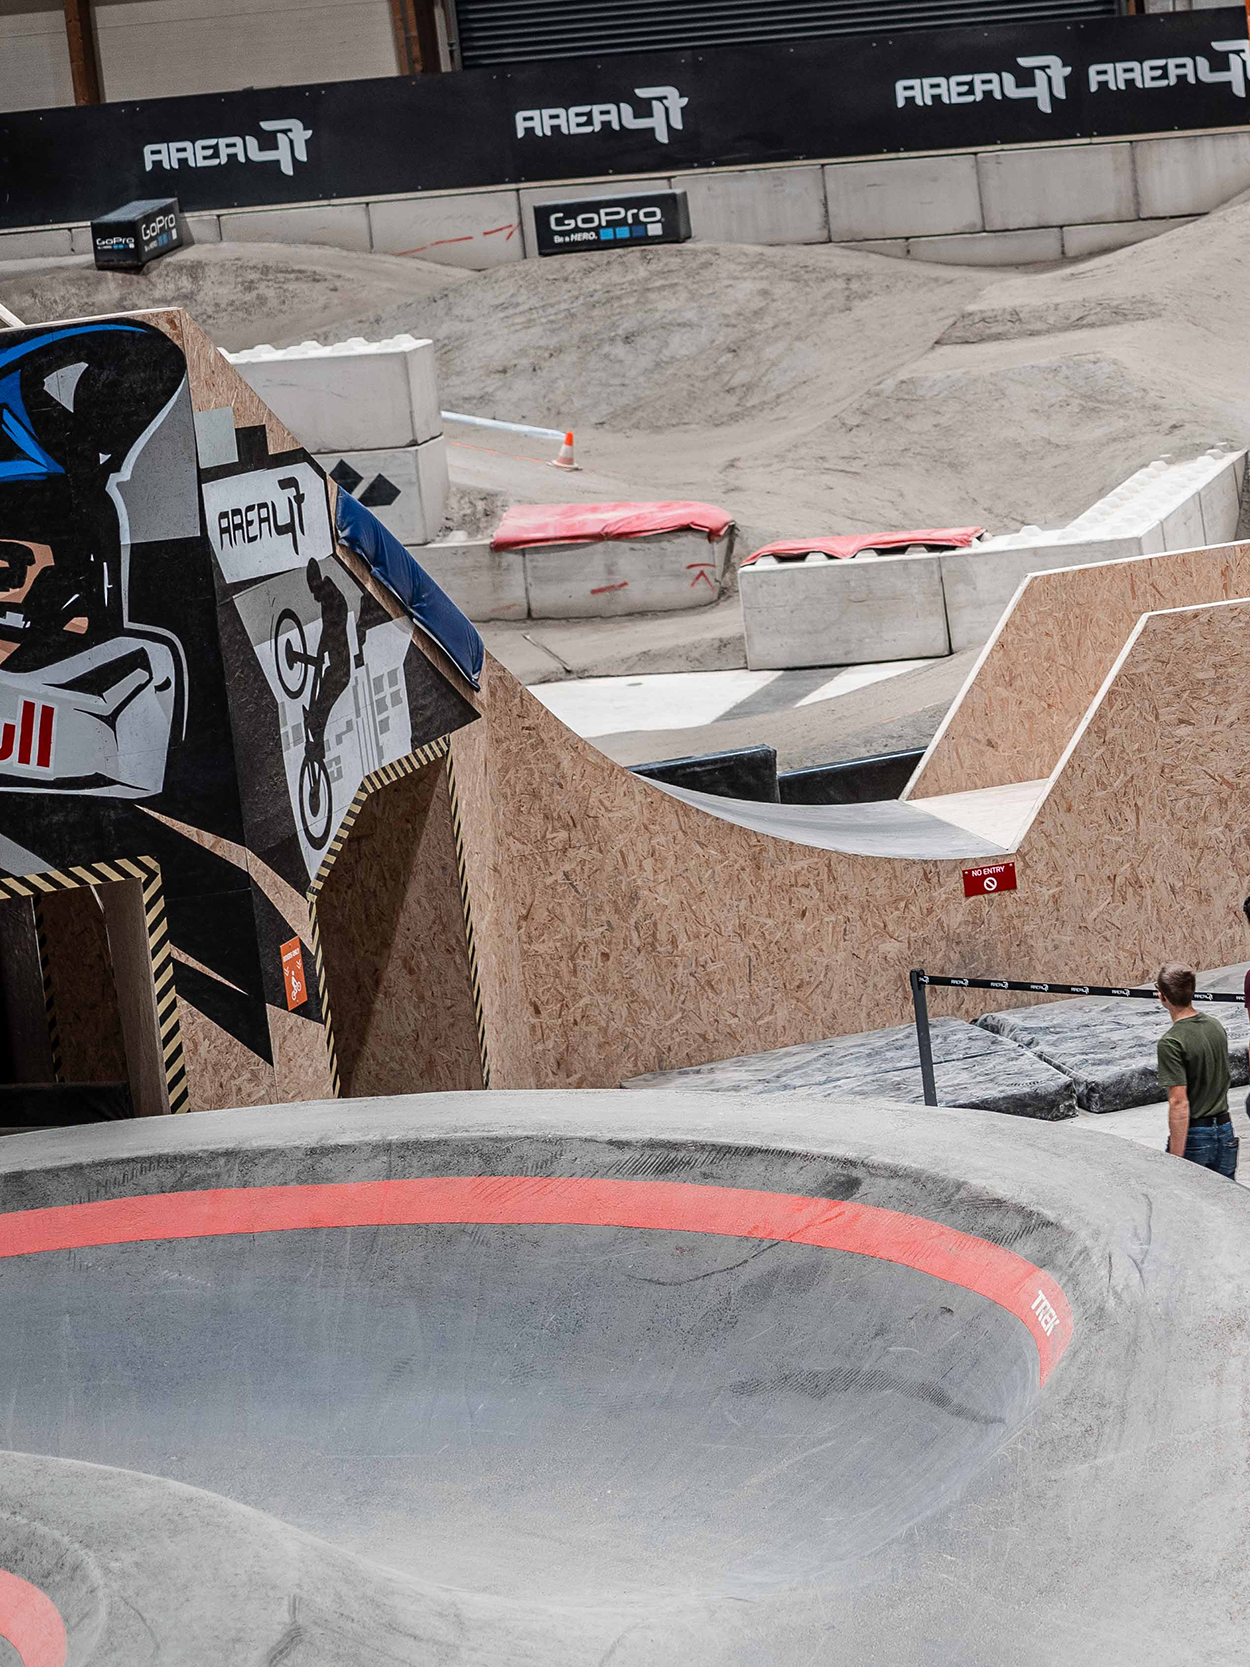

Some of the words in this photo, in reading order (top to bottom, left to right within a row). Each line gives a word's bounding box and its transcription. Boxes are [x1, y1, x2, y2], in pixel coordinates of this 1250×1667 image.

[141, 213, 176, 240] GoPro
[550, 207, 662, 231] GoPro
[96, 236, 135, 246] GoPro
[971, 869, 983, 877] NO
[983, 865, 1005, 876] ENTRY
[1031, 1289, 1060, 1337] TREK
